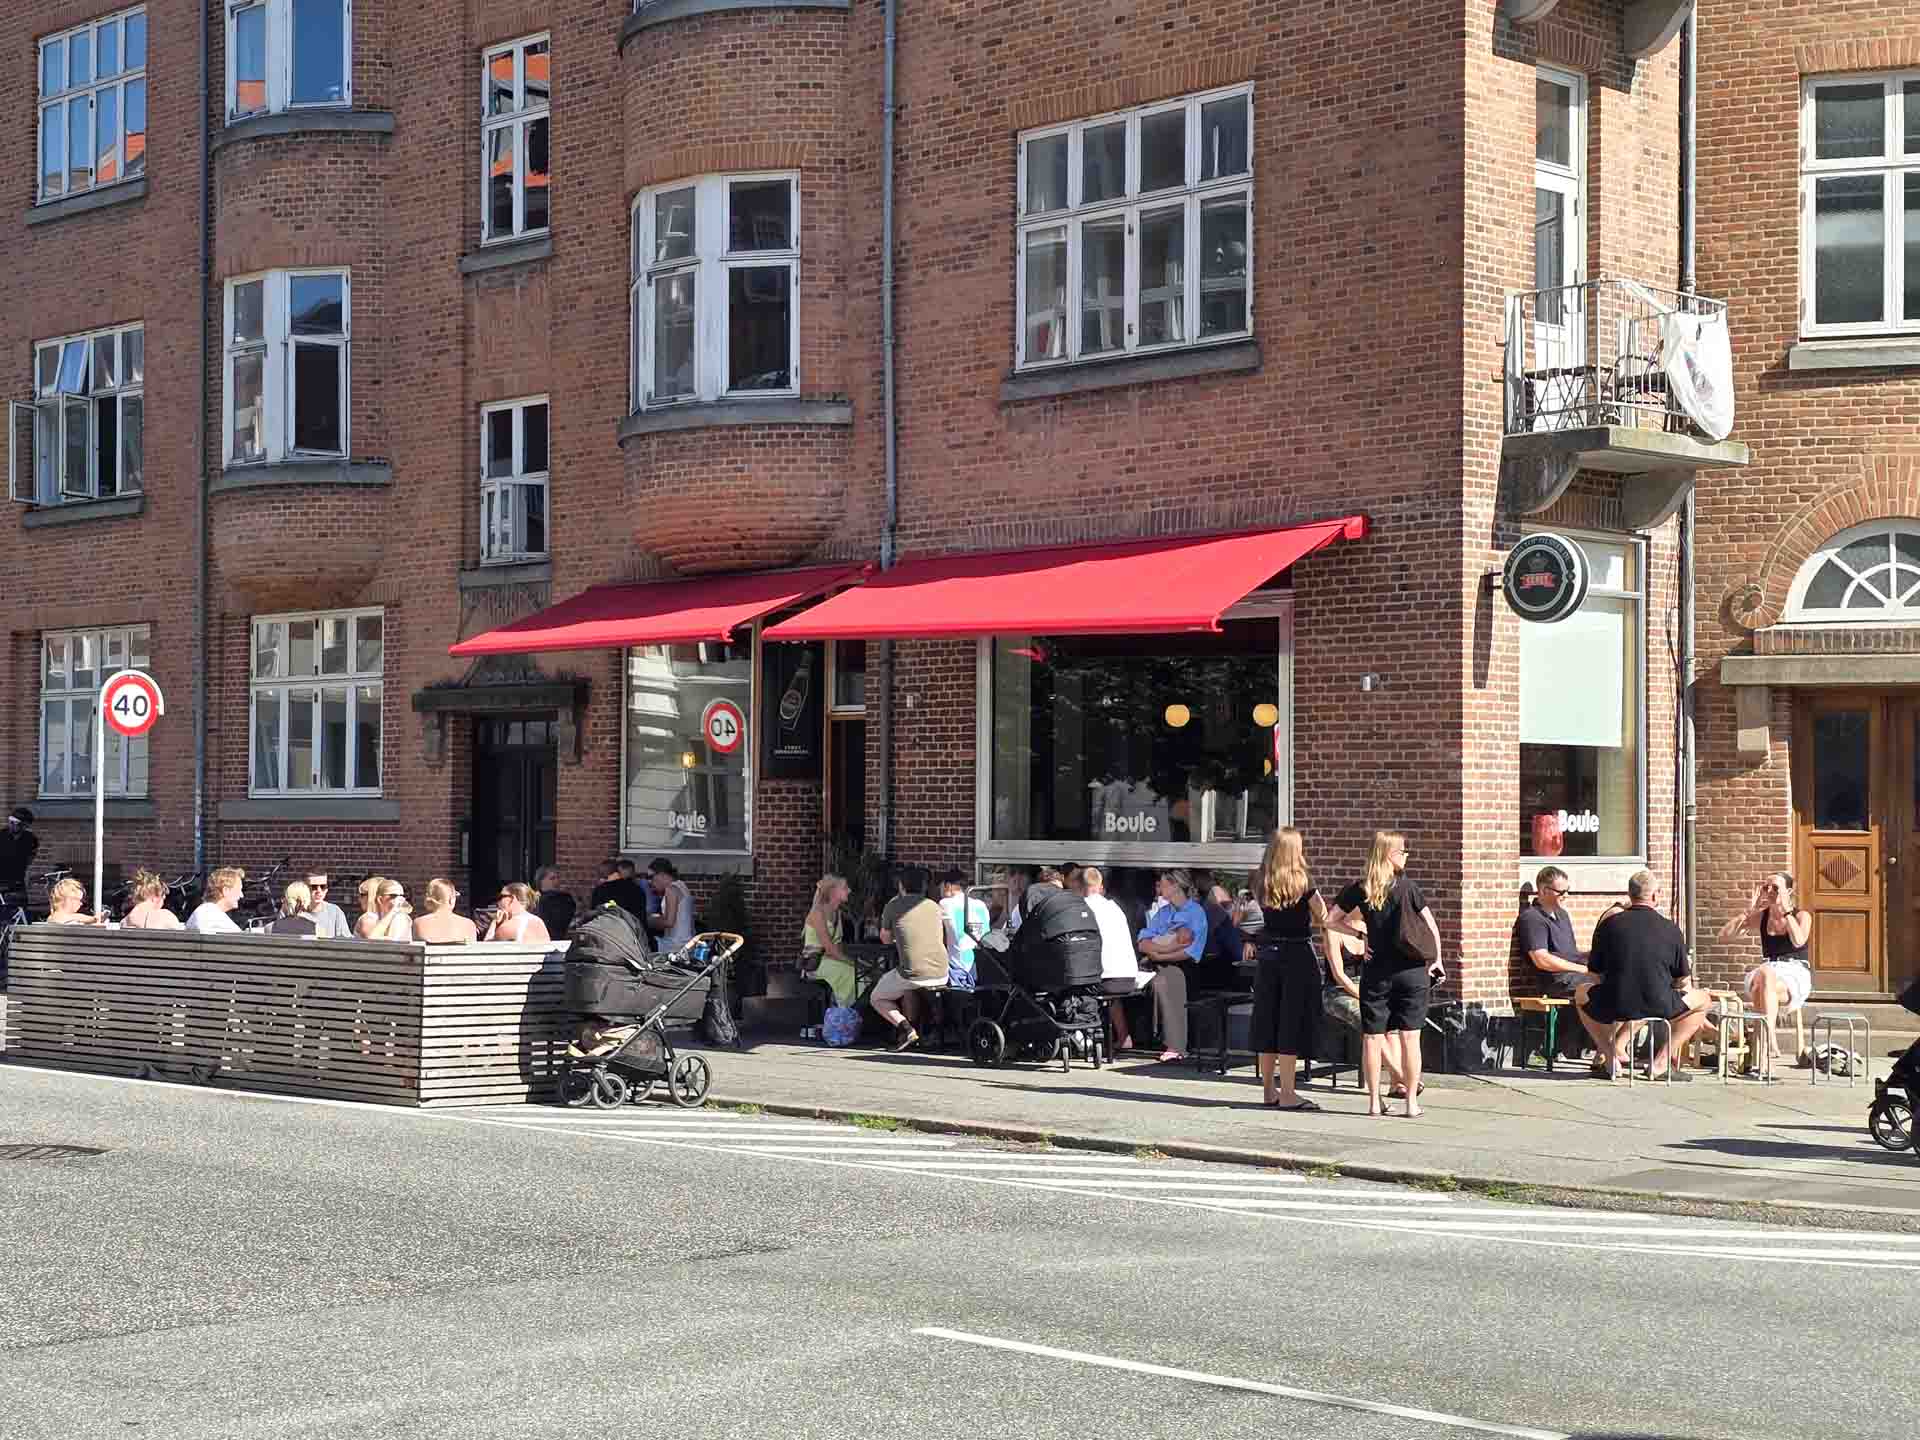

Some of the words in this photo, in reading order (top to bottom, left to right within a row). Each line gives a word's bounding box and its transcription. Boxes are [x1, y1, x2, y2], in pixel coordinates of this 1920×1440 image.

[114, 694, 148, 717] 40
[668, 810, 706, 829] Boule
[1105, 811, 1157, 832] Boule
[1558, 809, 1600, 832] Boule
